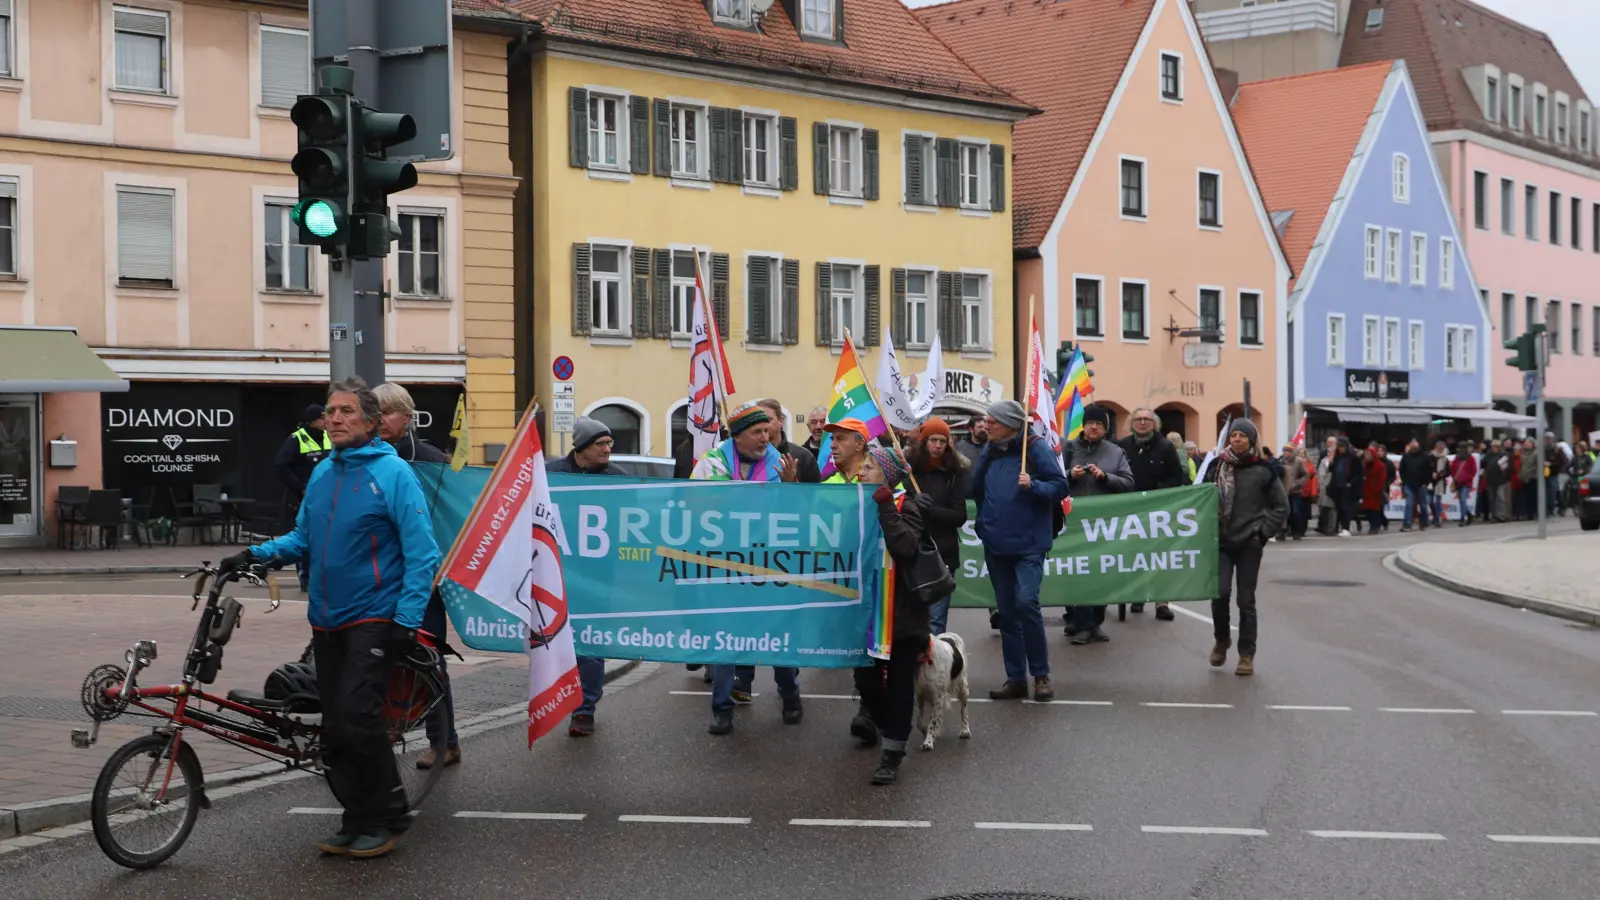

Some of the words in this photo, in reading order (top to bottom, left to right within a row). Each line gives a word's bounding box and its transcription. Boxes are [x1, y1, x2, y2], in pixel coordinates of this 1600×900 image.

[945, 371, 974, 394] RKET
[1180, 381, 1204, 397] KLEIN
[108, 408, 234, 427] DIAMOND
[124, 455, 174, 463] COCKTAIL
[176, 455, 183, 463] &
[152, 464, 194, 473] LOUNGE
[1081, 508, 1199, 542] WARS
[618, 547, 652, 562] STATT
[1044, 556, 1090, 576] THE
[1100, 550, 1201, 574] PLANET
[659, 543, 853, 588] AUFRÜSTEN
[465, 616, 525, 639] Abrüst
[580, 624, 613, 645] das
[617, 626, 675, 648] Gebot
[679, 629, 712, 650] der
[714, 630, 790, 652] Stunde!
